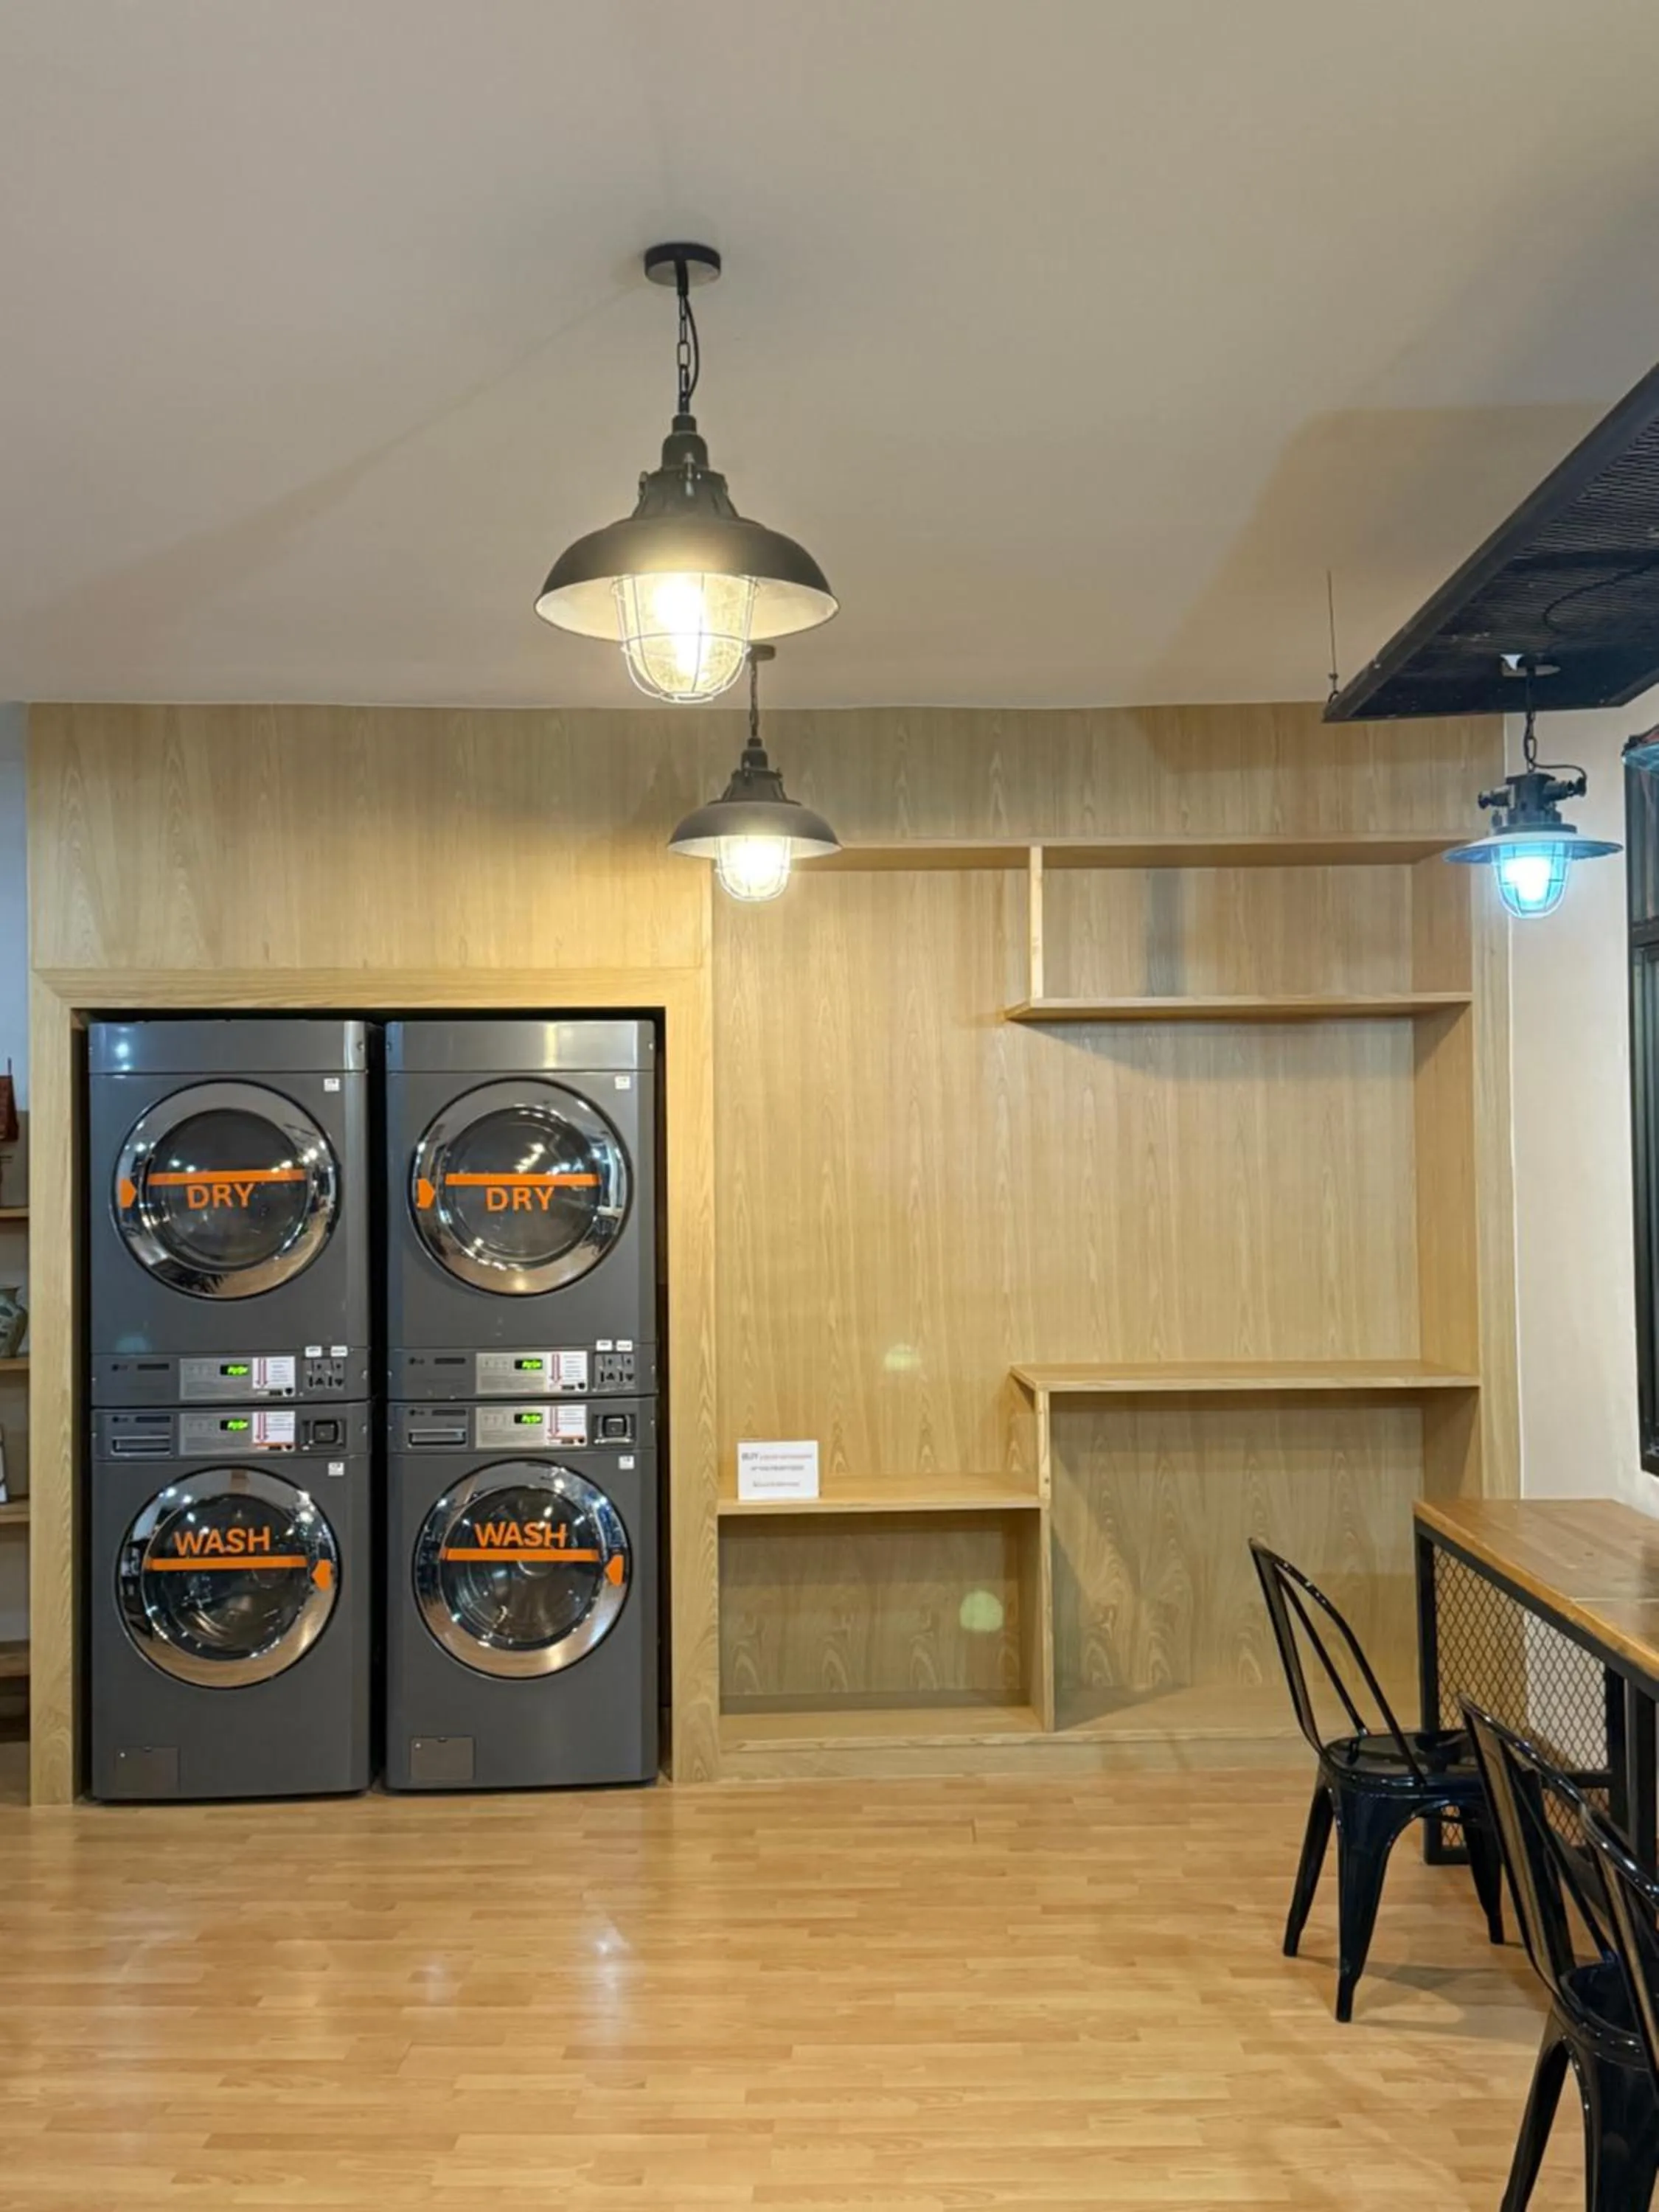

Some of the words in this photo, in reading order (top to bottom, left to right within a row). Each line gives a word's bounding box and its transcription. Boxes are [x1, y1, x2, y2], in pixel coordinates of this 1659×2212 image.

[187, 1183, 254, 1209] DRY
[487, 1186, 554, 1211] DRY
[173, 1526, 271, 1555] WASH
[474, 1521, 567, 1548] WASH
